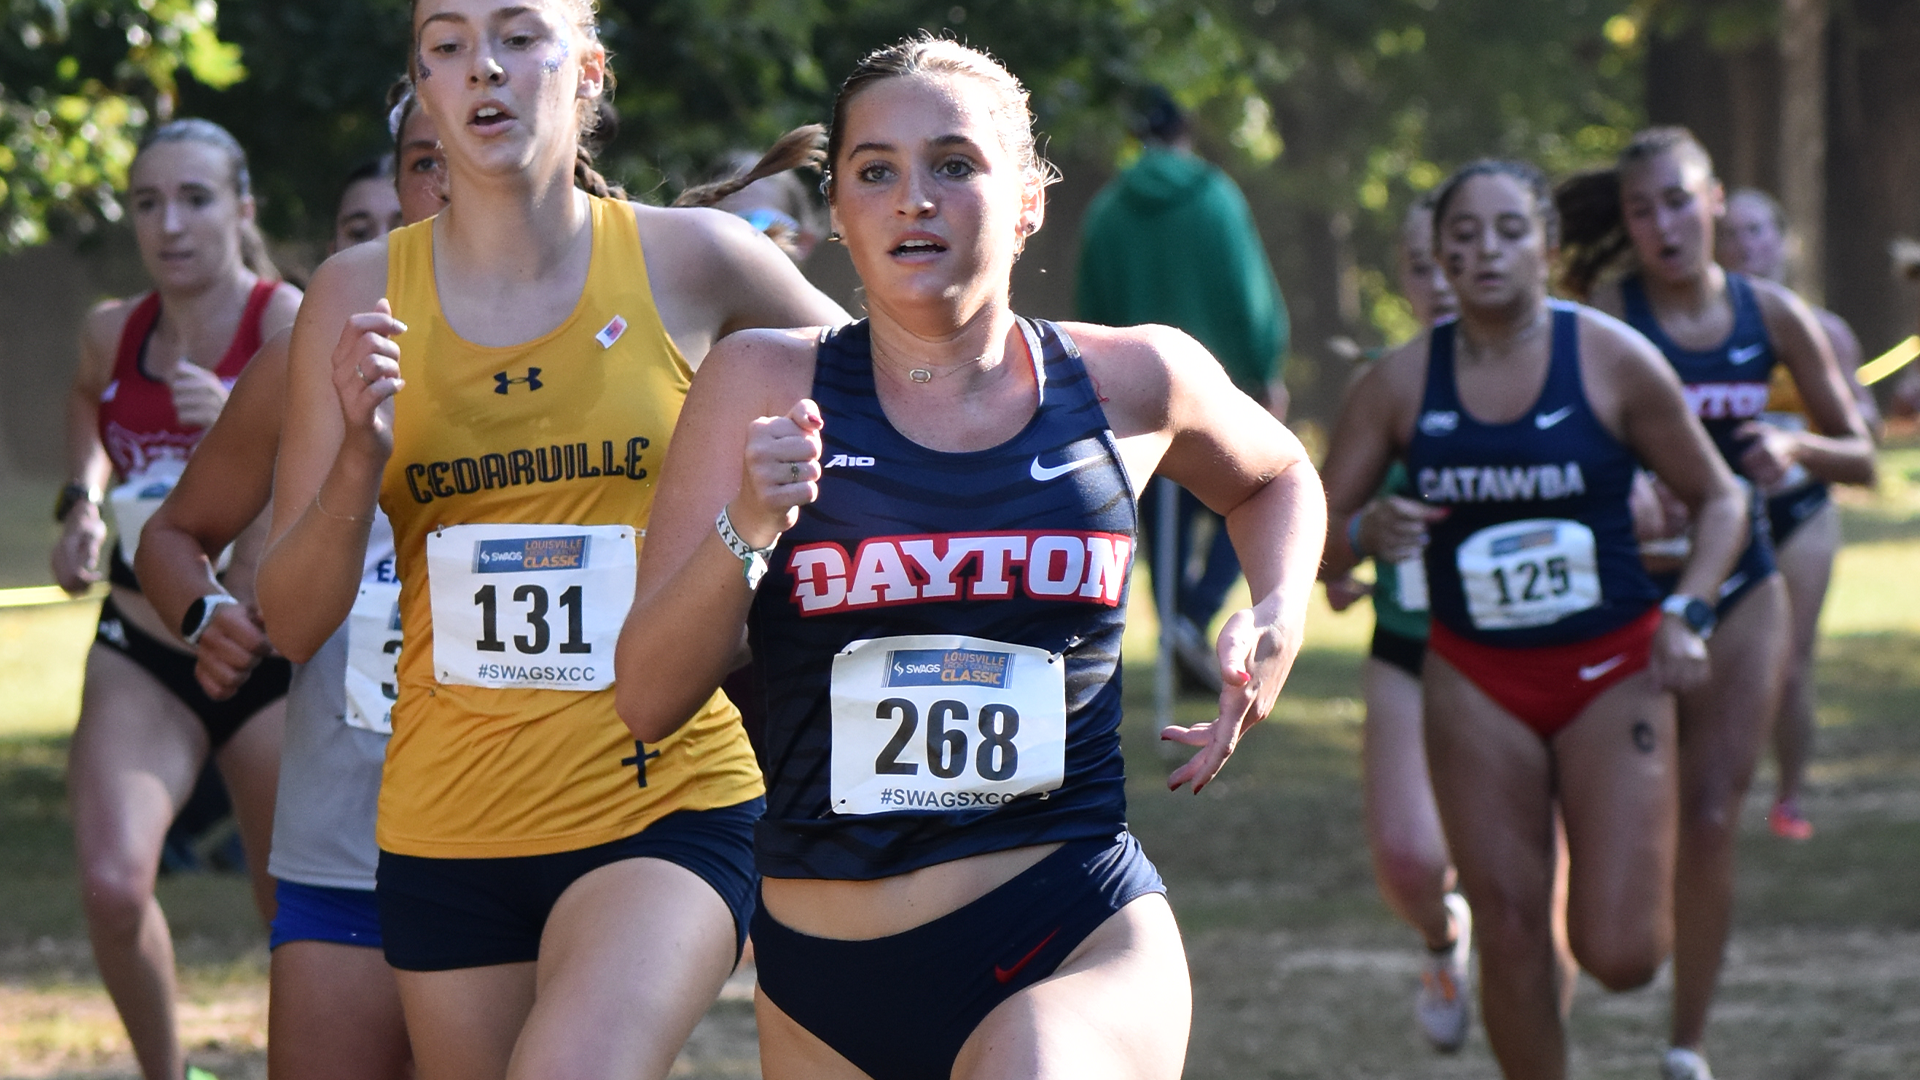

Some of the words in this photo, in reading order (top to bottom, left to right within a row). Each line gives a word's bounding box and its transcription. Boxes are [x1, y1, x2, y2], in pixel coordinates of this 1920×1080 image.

[824, 454, 876, 469] A10
[405, 437, 650, 504] CEDARVILLE
[1418, 461, 1586, 502] CATAWBA
[525, 538, 583, 550] LOUISVILLE
[491, 551, 523, 562] SWAGS
[523, 555, 579, 569] CLASSIC
[788, 534, 1131, 614] DAYTON
[1493, 556, 1569, 605] 125
[474, 584, 592, 655] 131
[944, 651, 1005, 667] LOUISVILLE
[478, 663, 595, 682] #SWAGSXCC
[906, 663, 941, 674] SWAGS
[941, 669, 1002, 685] CLASSIC
[875, 697, 1020, 781] 268
